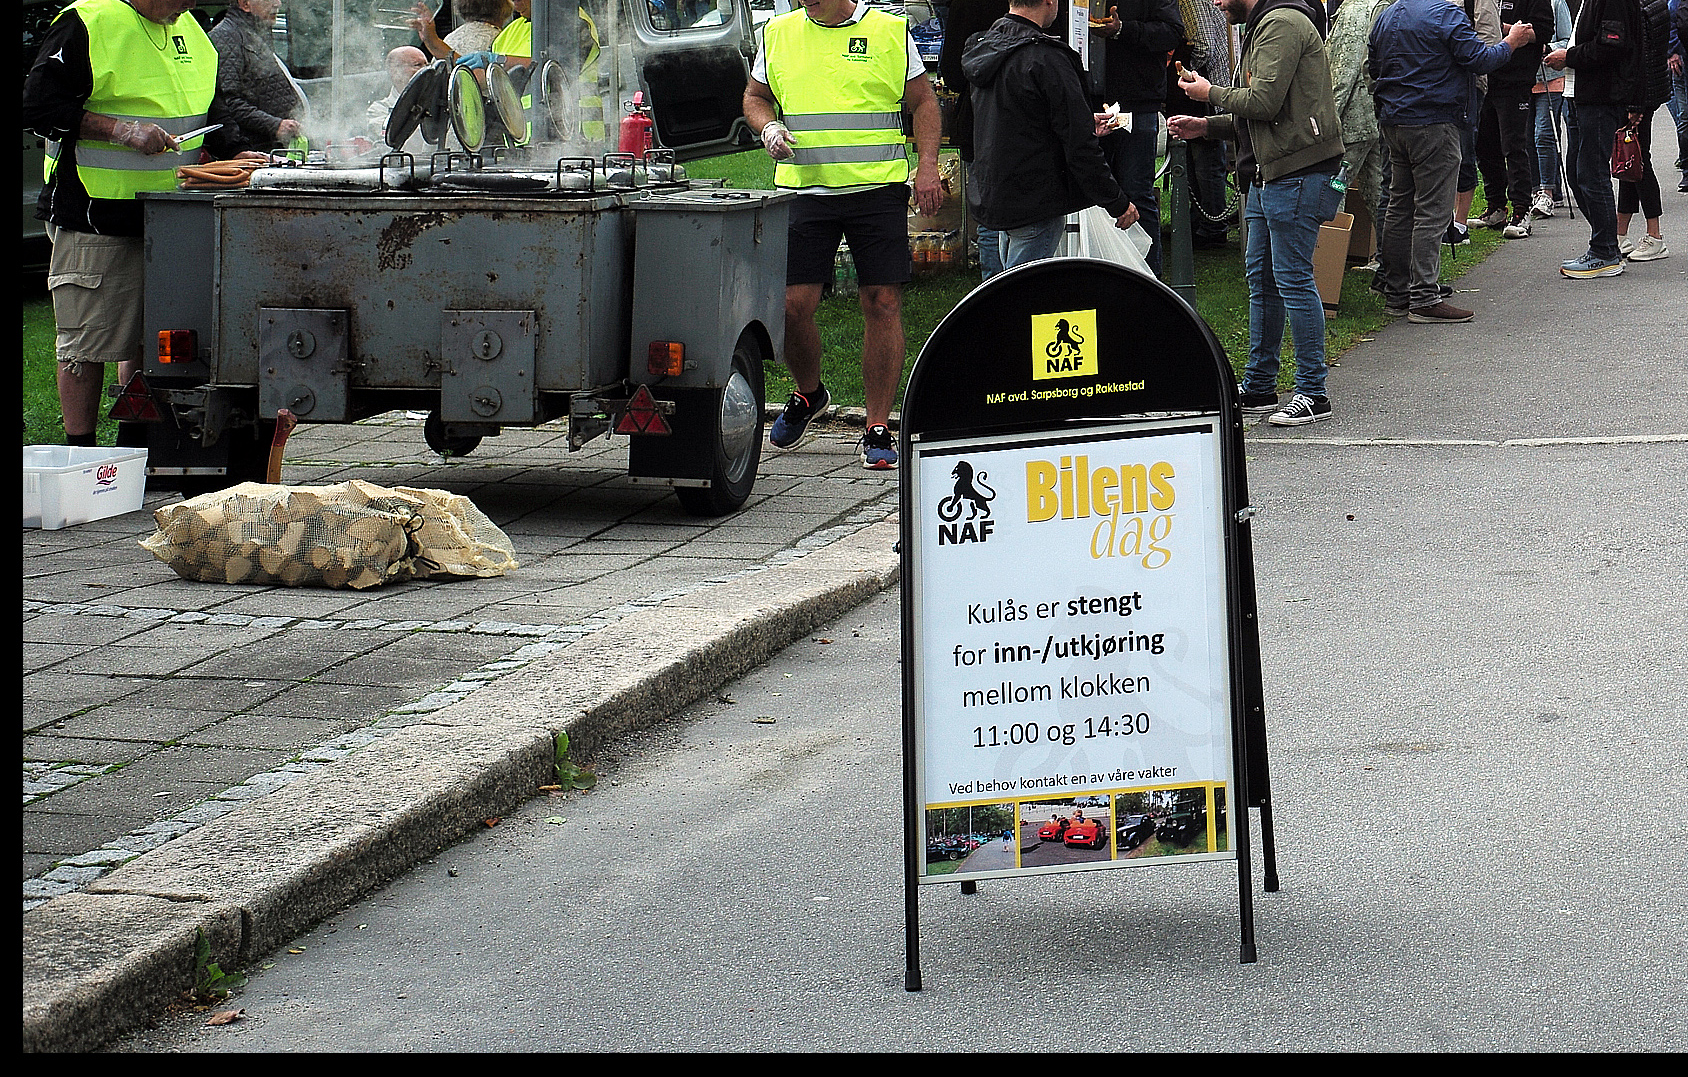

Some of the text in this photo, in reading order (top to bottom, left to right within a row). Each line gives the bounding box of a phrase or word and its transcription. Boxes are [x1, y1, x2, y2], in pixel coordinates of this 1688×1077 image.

[1046, 356, 1083, 374] NAF
[986, 379, 1145, 404] NAF avd. Sarpsborg og Rakkestad
[96, 464, 118, 480] Gilde
[1025, 455, 1176, 523] Bilens
[938, 500, 1177, 570] NAF dag
[968, 591, 1142, 625] Kulås er stengt
[952, 630, 1165, 667] for inn-/utkjøring
[963, 672, 1150, 708] mellom klokken
[973, 712, 1150, 748] 11:00 og 14:30
[949, 765, 1178, 795] Ved behov kontakt en av våre vakter
